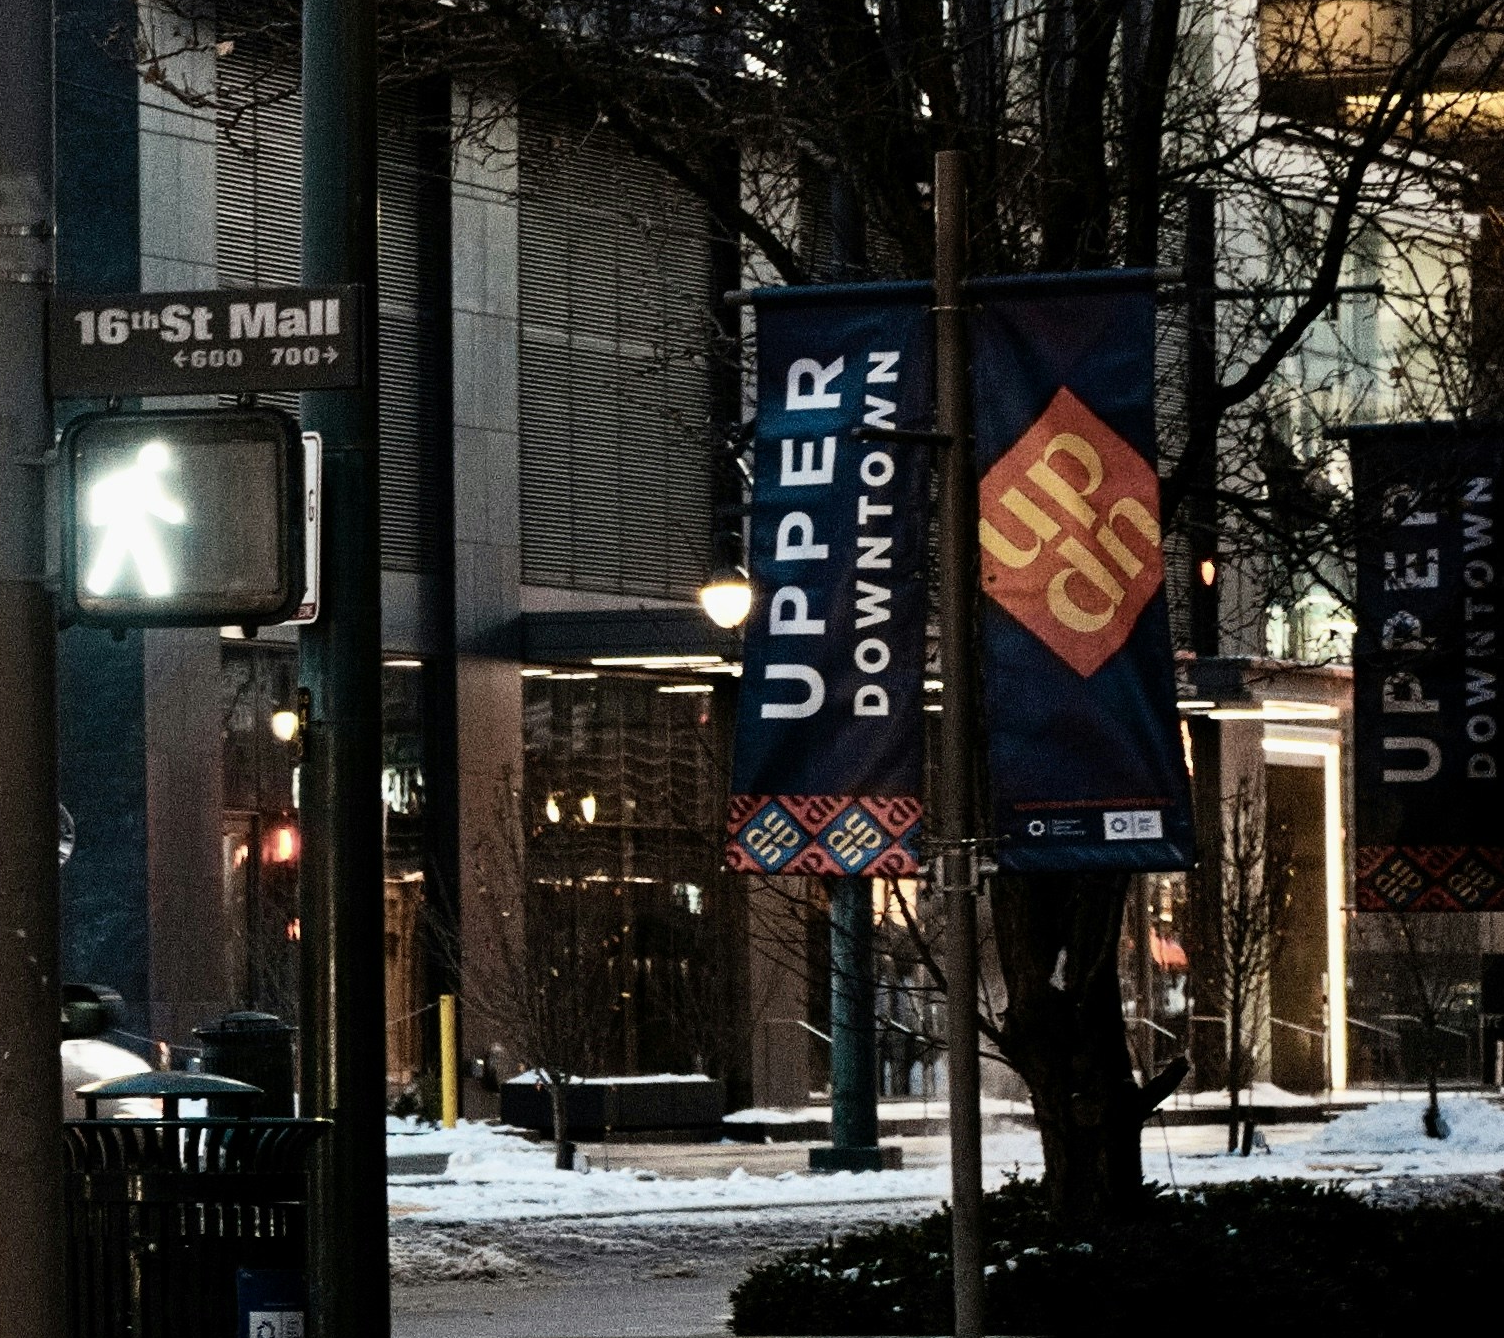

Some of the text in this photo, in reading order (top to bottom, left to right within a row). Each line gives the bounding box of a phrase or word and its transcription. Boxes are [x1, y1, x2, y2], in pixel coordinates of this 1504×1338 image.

[74, 297, 340, 345] 16th St Mall
[190, 346, 322, 368] 600 700
[760, 353, 845, 721] UPPER
[852, 349, 902, 717] DOWNTOWN
[977, 431, 1105, 571] up
[1044, 494, 1162, 634] dn
[1381, 481, 1444, 784] UPPER
[1463, 475, 1499, 779] DOWNTOWN
